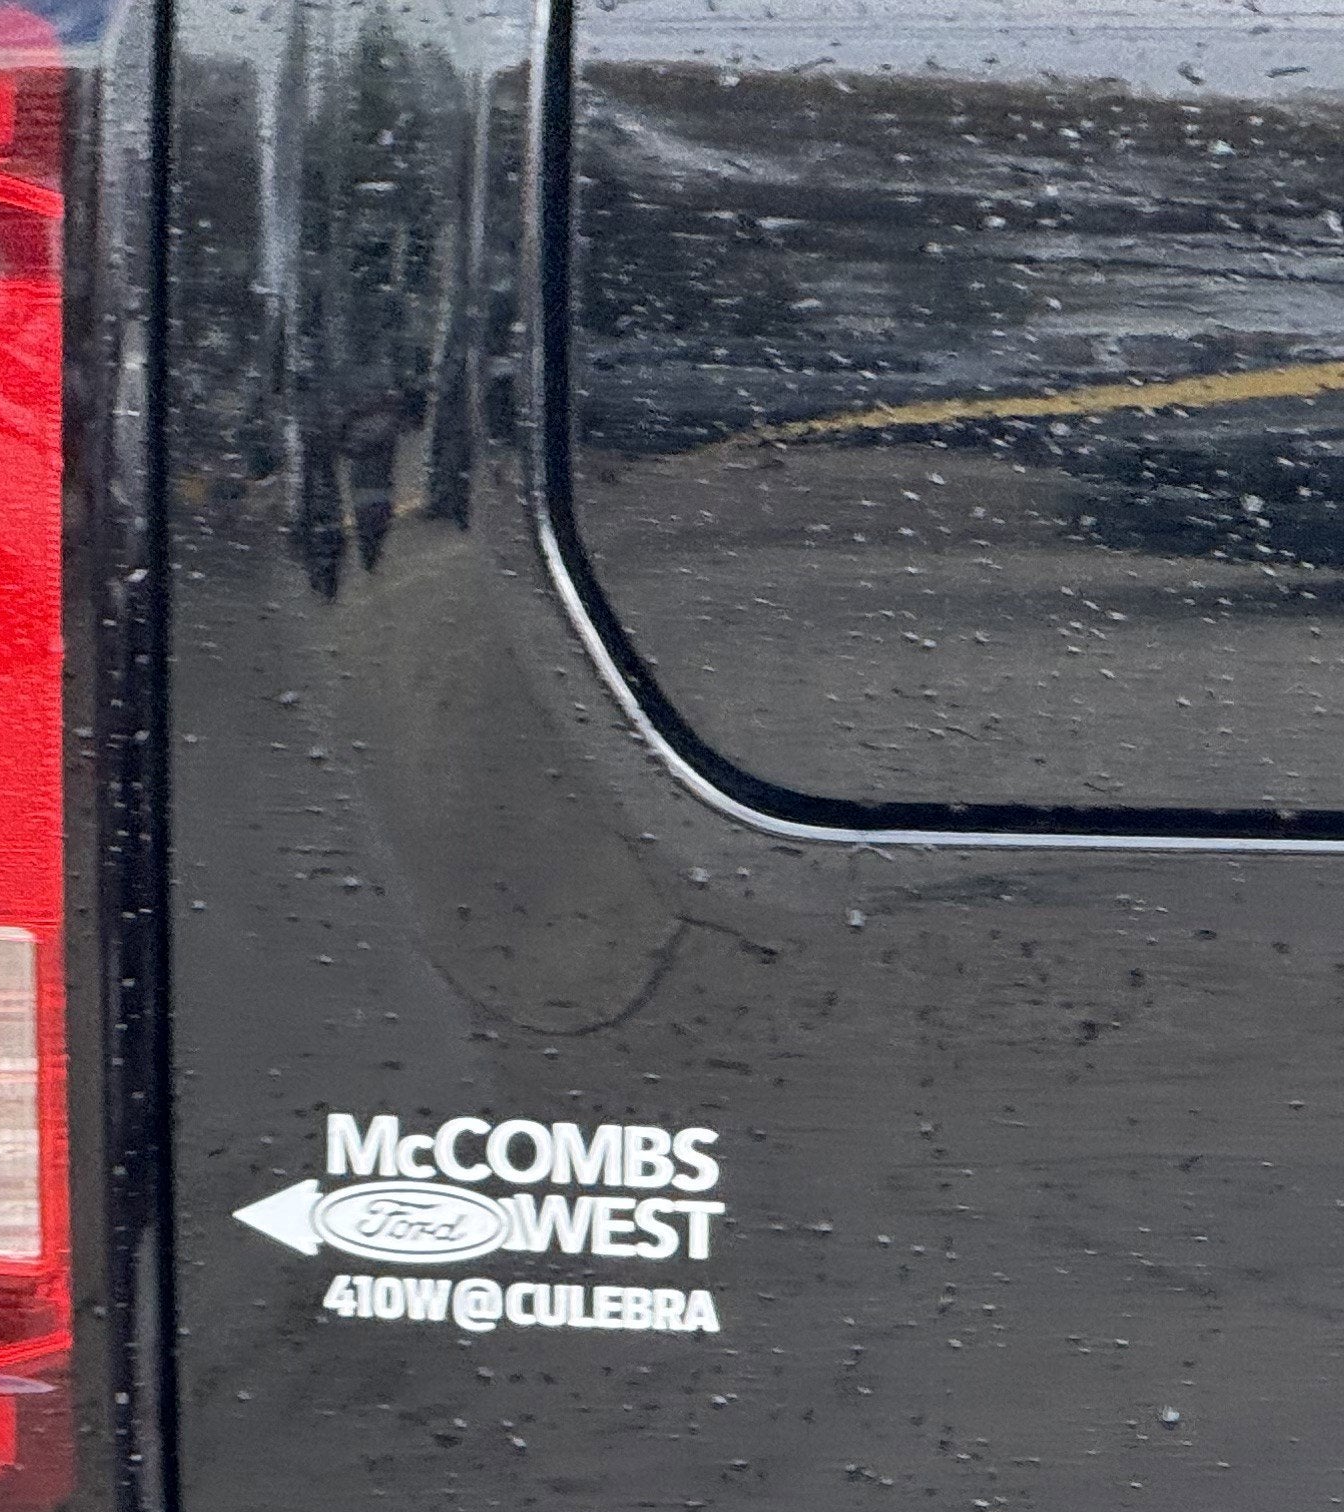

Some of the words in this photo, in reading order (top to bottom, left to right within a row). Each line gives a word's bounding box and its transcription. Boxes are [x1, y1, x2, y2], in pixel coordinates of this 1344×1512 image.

[326, 1112, 720, 1192] McCOMBS
[356, 1198, 468, 1243] Ford
[501, 1193, 726, 1260] WEST
